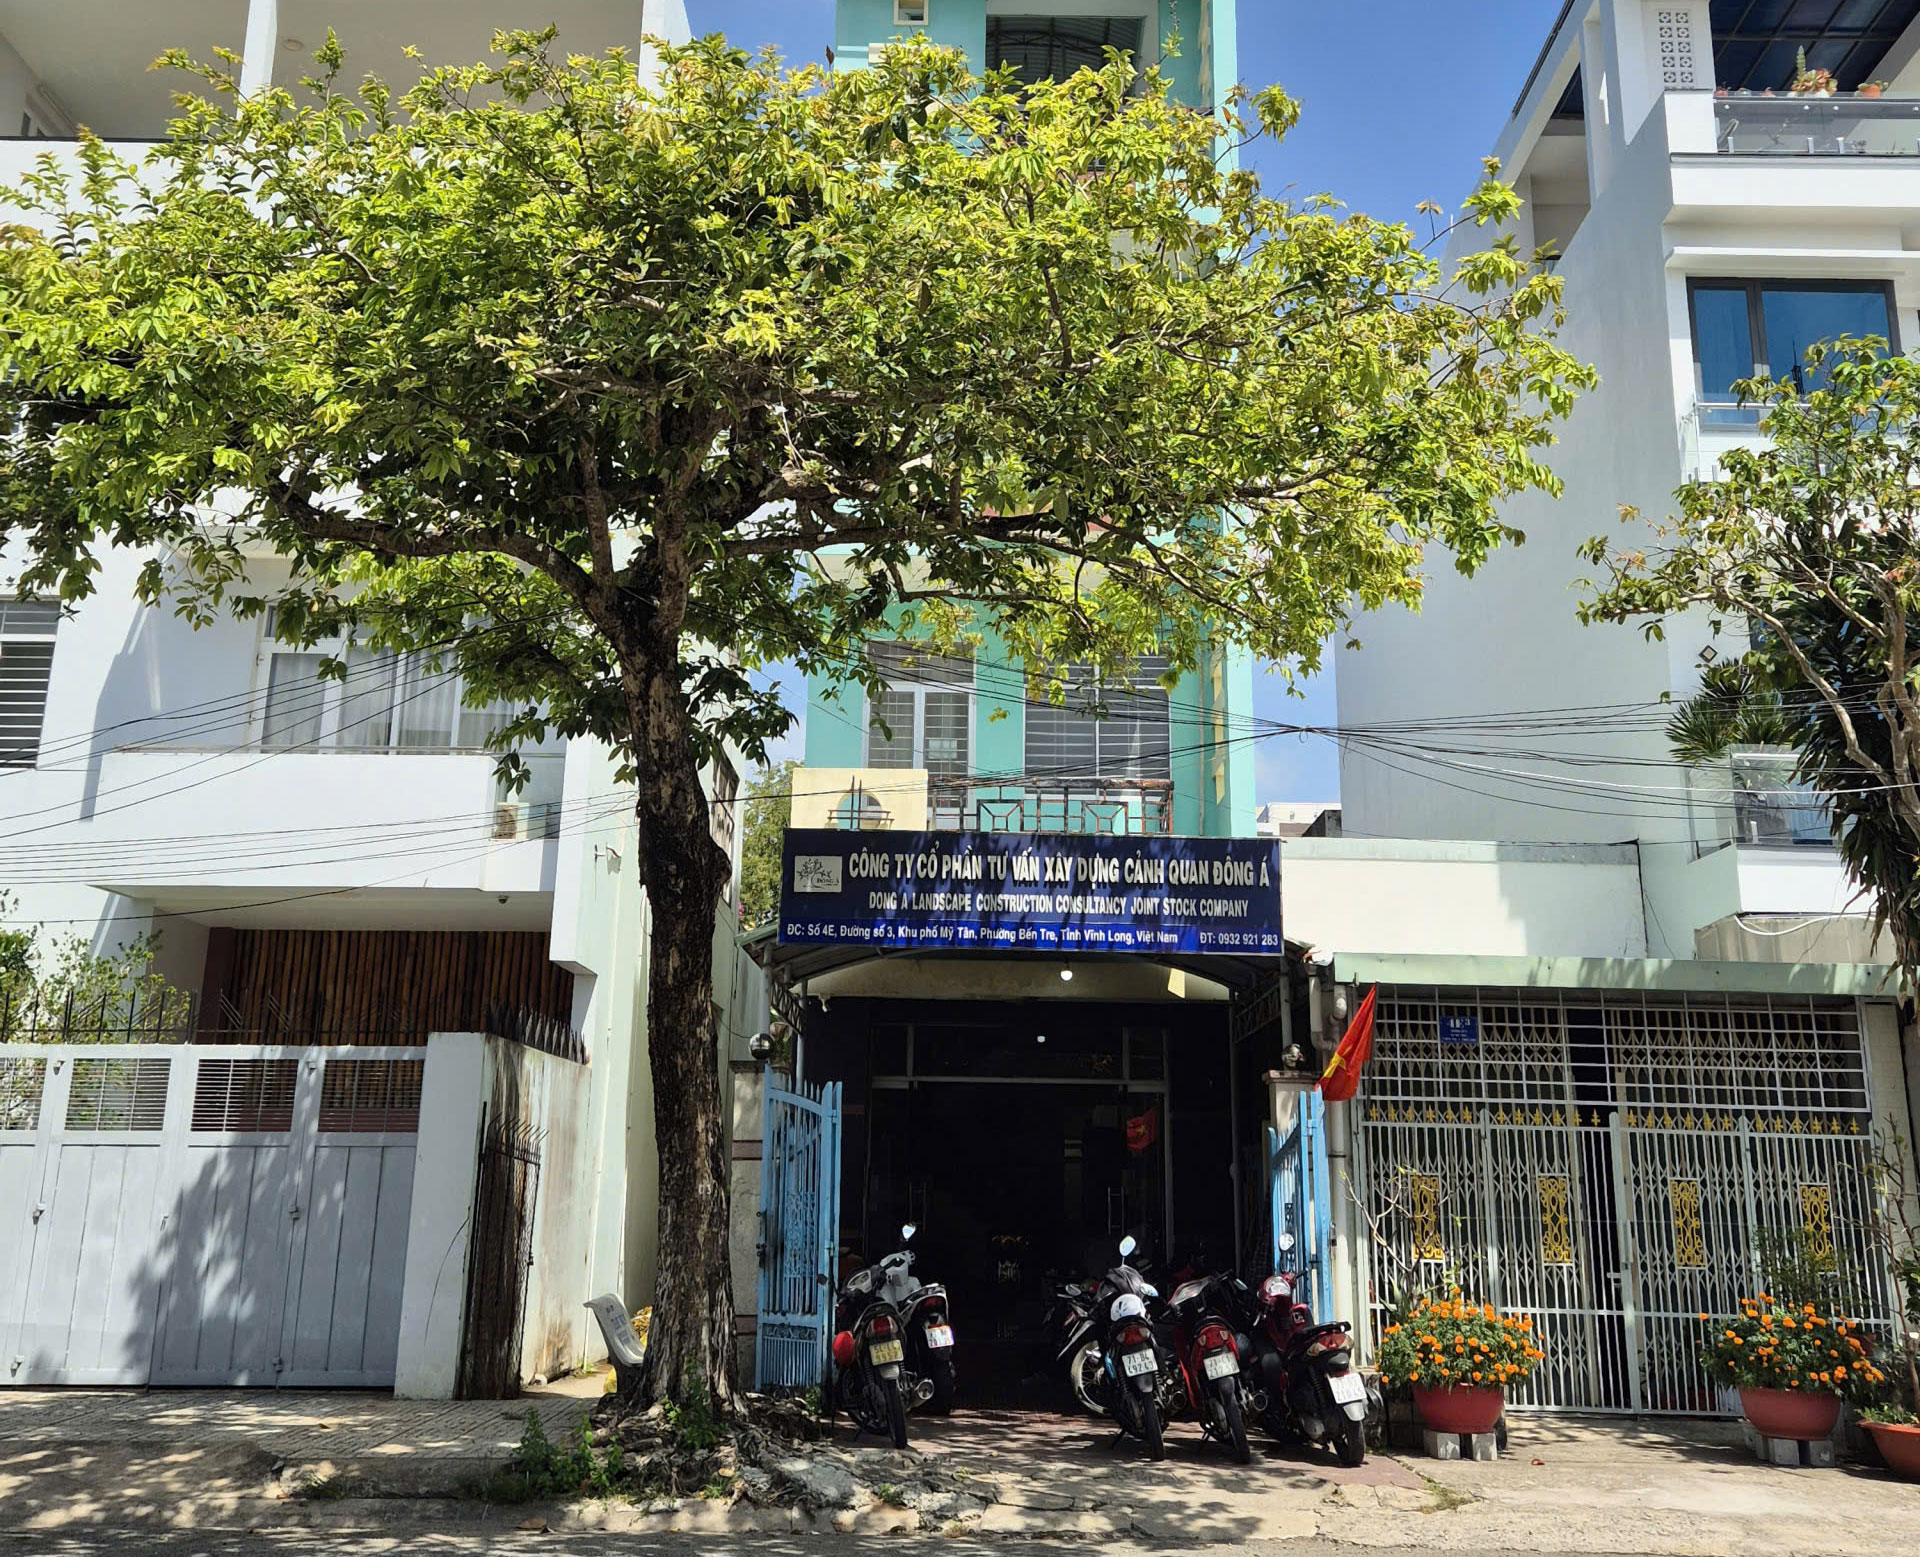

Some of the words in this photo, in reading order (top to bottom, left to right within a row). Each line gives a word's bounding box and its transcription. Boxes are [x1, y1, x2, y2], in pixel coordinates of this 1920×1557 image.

[849, 848, 889, 878] CÔNG
[894, 853, 914, 879] TY
[917, 841, 938, 879] CỔ
[942, 845, 982, 880] PHẦN
[987, 851, 1008, 880] TƯ
[1012, 847, 1039, 881] VẤN
[1044, 852, 1073, 882] XÂY
[1078, 853, 1119, 889] DỰNG
[1124, 850, 1164, 884] CẢNH
[1168, 859, 1209, 886] QUAN
[1213, 856, 1254, 887] ĐÔNG
[1259, 856, 1269, 887] Á
[869, 892, 897, 910] DONG
[901, 892, 908, 910] A
[912, 893, 972, 912] LANDSCAPE
[976, 894, 1052, 914] CONSTRUCTION
[1056, 895, 1126, 915] CONSULTANCY
[1131, 897, 1159, 915] JOINT
[1162, 898, 1197, 916] STOCK
[1200, 899, 1248, 917] COMPANY
[787, 924, 805, 936] ĐC:
[808, 923, 820, 936] Số
[822, 925, 837, 938] 4E,
[840, 924, 870, 939] Đường
[873, 924, 885, 937] số
[887, 926, 895, 939] 3,
[898, 926, 918, 938] Khu
[920, 925, 938, 941] phố
[940, 926, 954, 942] Mỹ
[957, 926, 978, 941] Tân,
[980, 926, 1016, 943] Phường
[1019, 926, 1037, 941] Bến
[1040, 929, 1058, 943] Tre,
[1084, 928, 1105, 942] Vĩnh
[1108, 929, 1134, 945] Long,
[1136, 930, 1154, 944] Việt
[1157, 931, 1178, 944] Nam
[1200, 932, 1216, 944] ĐT:
[1218, 932, 1240, 945] 0932
[1243, 933, 1258, 945] 921
[1261, 934, 1278, 946] 283
